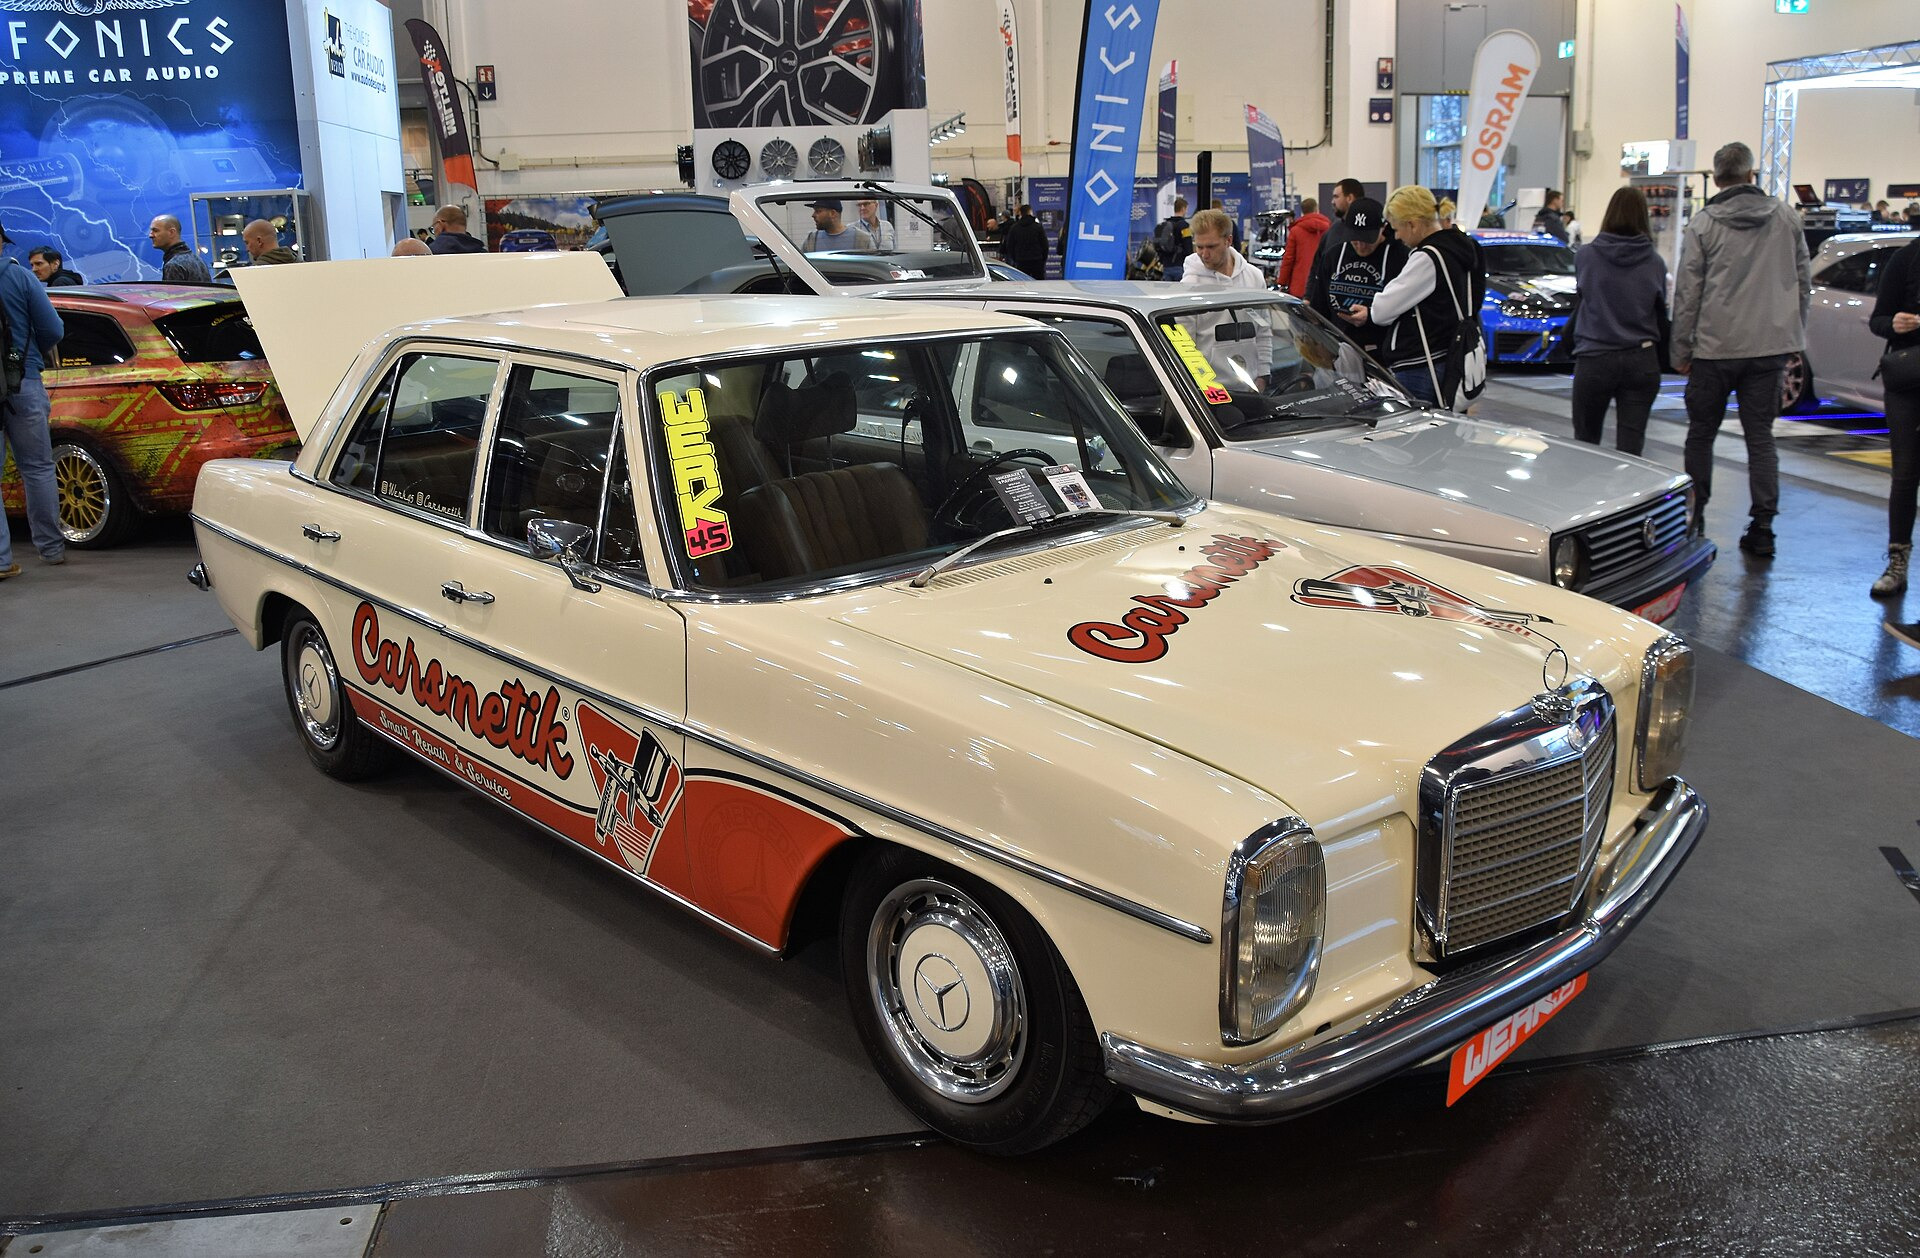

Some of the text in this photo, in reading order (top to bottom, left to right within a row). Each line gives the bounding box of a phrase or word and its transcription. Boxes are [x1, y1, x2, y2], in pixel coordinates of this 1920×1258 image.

[8, 16, 234, 60] FONICS
[0, 65, 220, 85] PREME CAR AUDIO
[353, 46, 385, 78] CAR AUDIO
[1471, 63, 1531, 171] OSRAM
[1075, 3, 1142, 270] IFONICS
[1329, 284, 1375, 296] ORIGINA
[1344, 274, 1369, 284] NO.1
[1207, 388, 1229, 401] 45
[689, 524, 728, 551] 45
[379, 709, 512, 801] Smart Repair & Service
